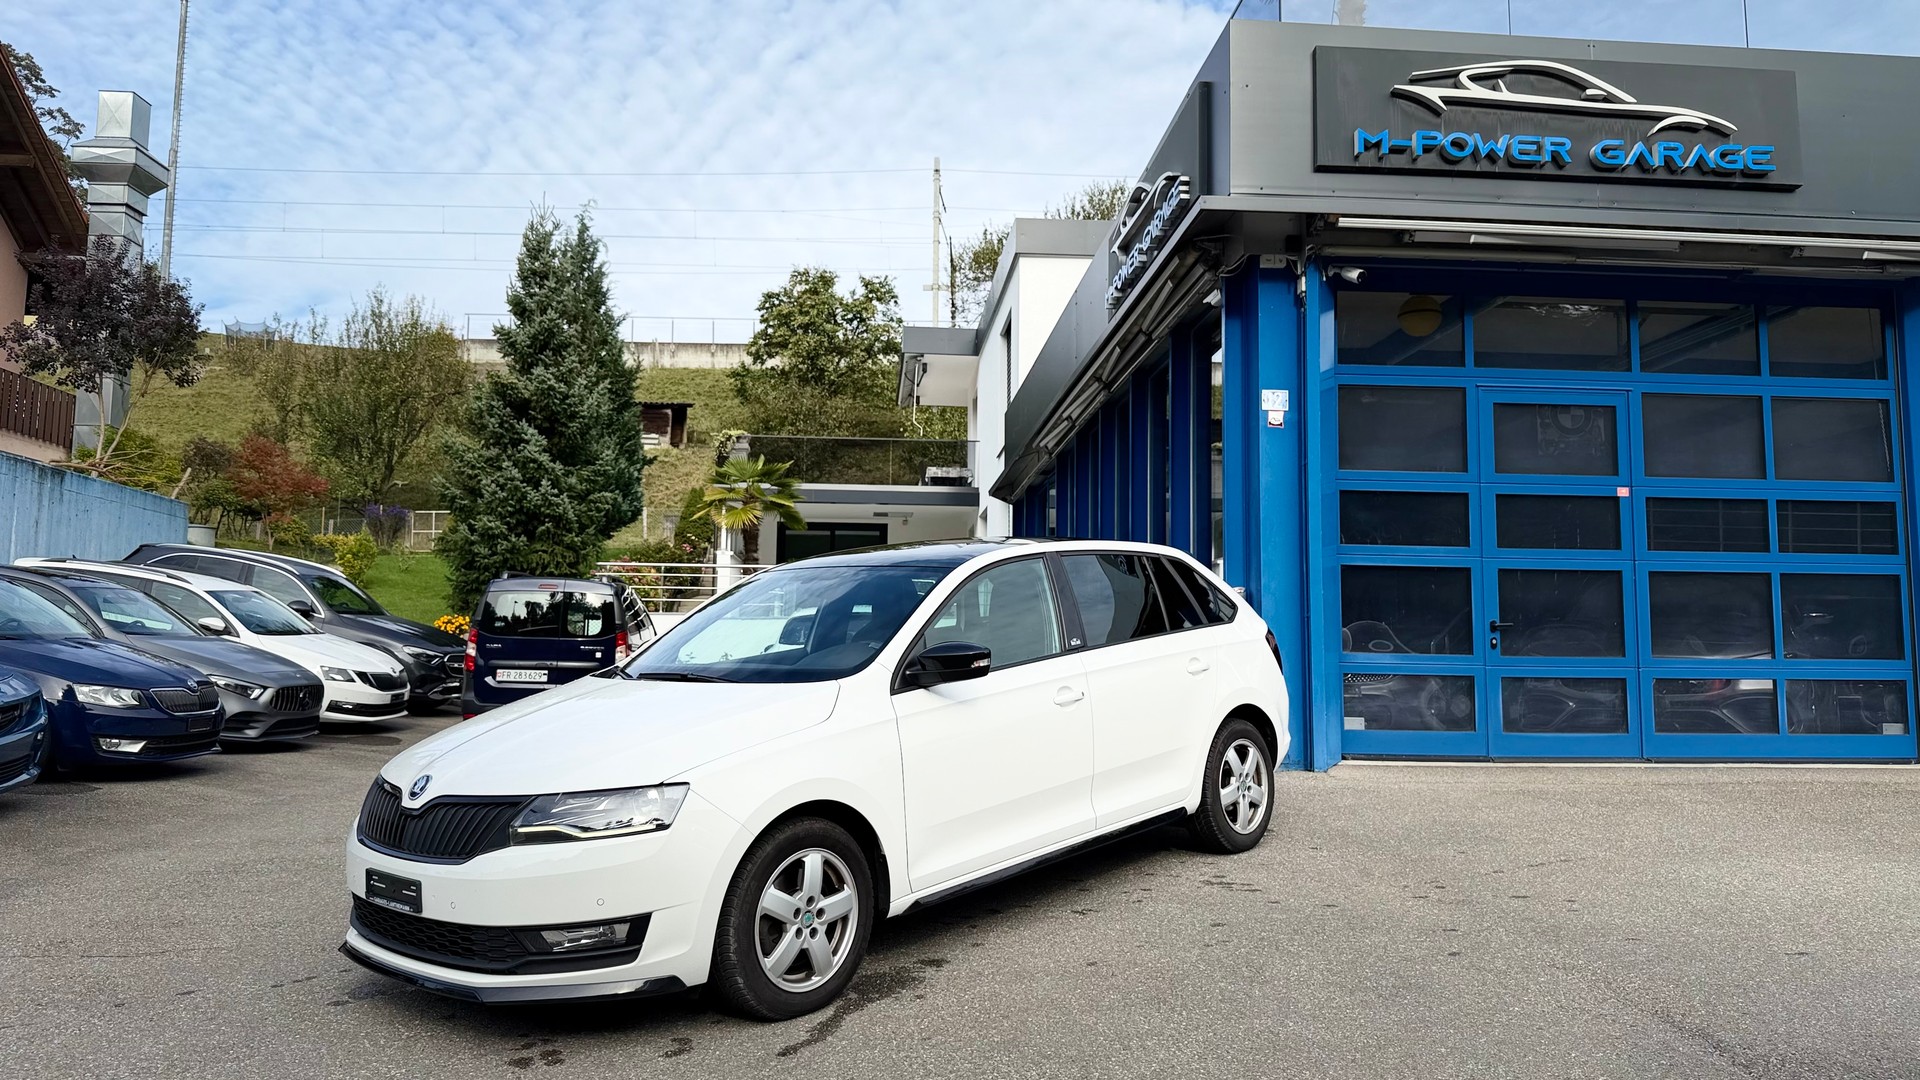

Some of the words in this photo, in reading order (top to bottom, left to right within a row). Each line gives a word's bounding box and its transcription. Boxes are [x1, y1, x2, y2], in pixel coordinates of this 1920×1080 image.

[1357, 128, 1572, 163] M-POWER
[1594, 139, 1776, 171] GARAGE
[501, 671, 512, 680] FR
[513, 671, 543, 681] 283629
